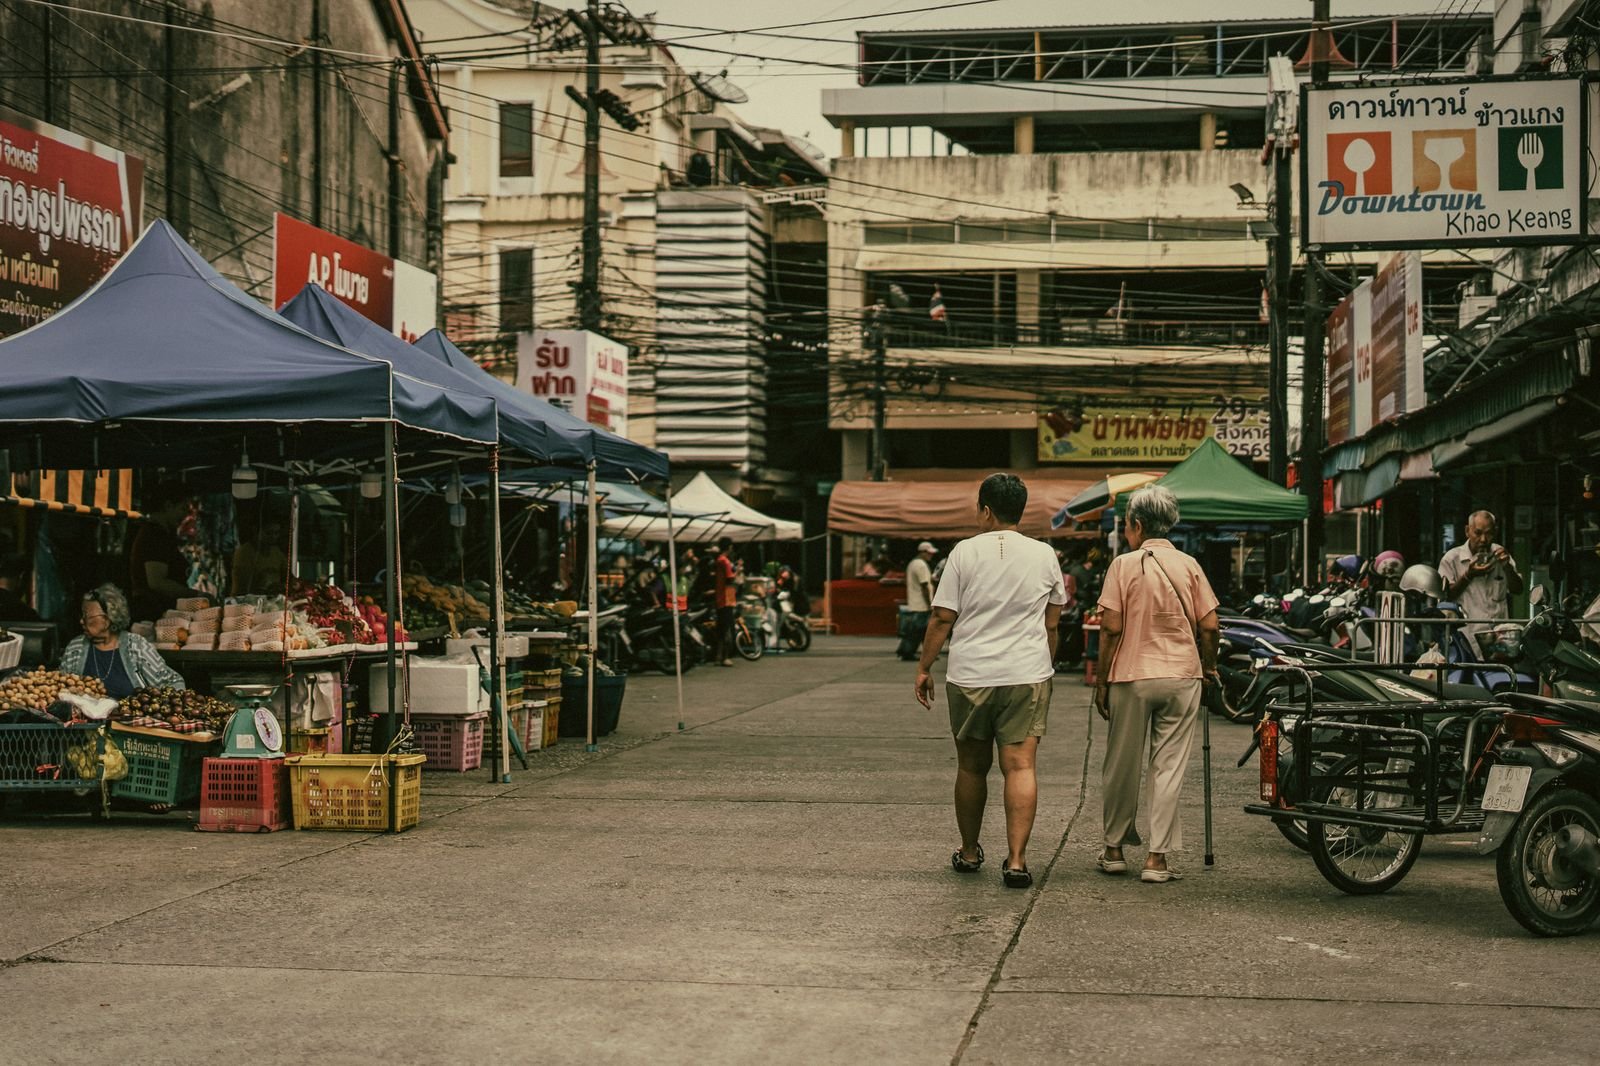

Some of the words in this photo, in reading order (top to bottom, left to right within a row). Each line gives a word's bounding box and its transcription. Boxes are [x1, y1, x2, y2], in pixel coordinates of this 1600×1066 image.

[1328, 87, 1471, 120] ดาวน์ทาวน์
[1475, 103, 1565, 127] ข้าวแกง
[1317, 180, 1486, 216] Downtown
[1446, 211, 1501, 237] Khao
[1508, 208, 1573, 234] Keang
[535, 337, 570, 369] รับ
